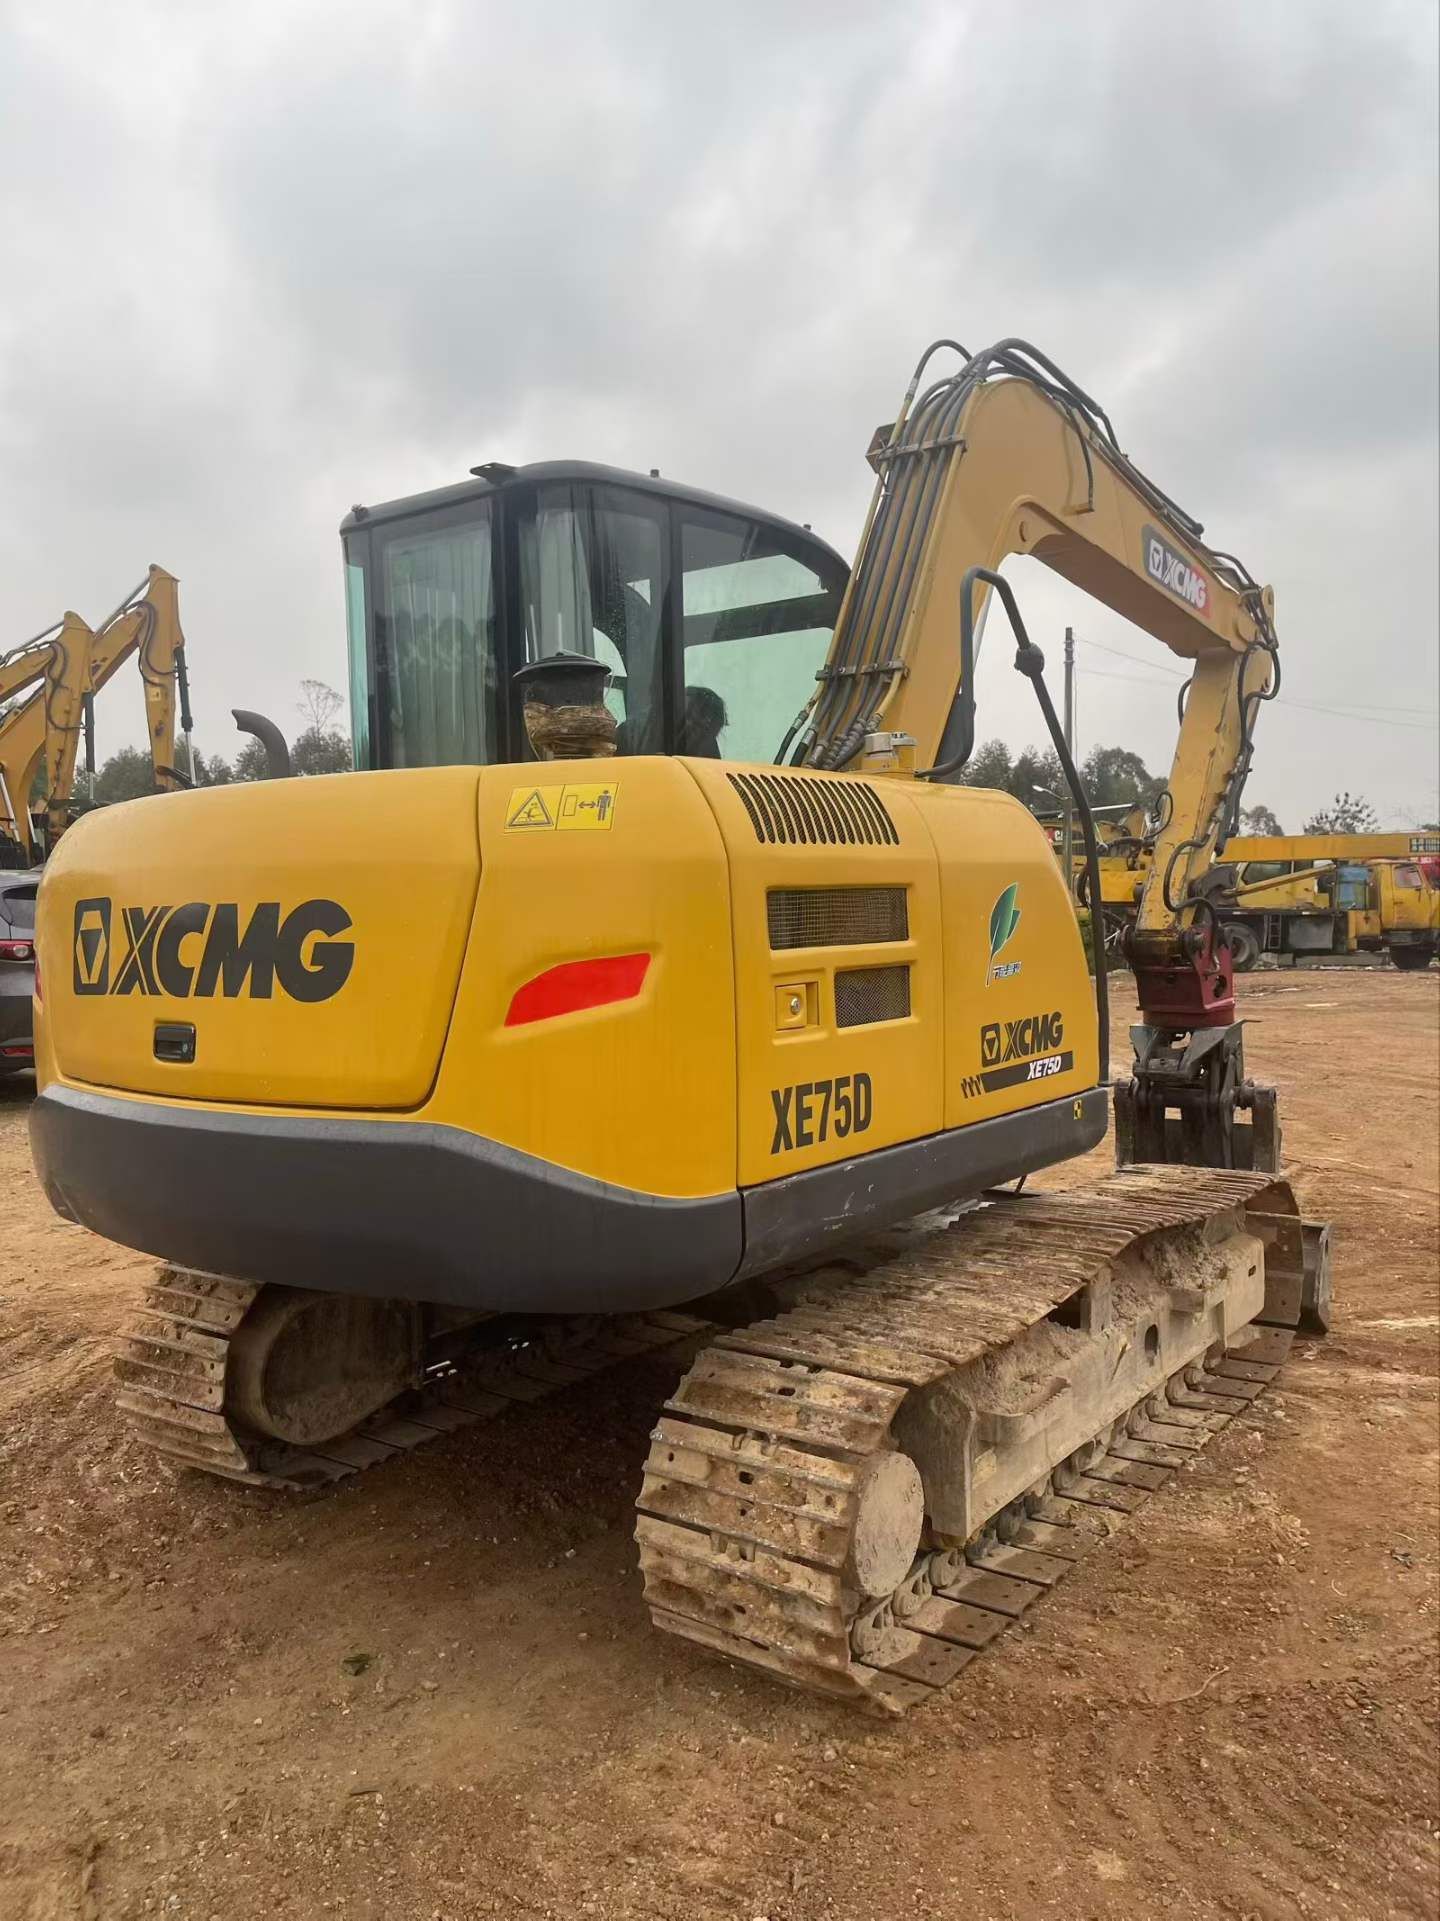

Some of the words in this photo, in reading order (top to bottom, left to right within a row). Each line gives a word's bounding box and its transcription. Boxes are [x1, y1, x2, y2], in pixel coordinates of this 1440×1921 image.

[1162, 552, 1207, 609] XCMG
[109, 898, 355, 1003] XCMG
[1002, 1011, 1063, 1063] XCMG
[1027, 1055, 1062, 1081] XE75D
[770, 1072, 872, 1155] XE75D
